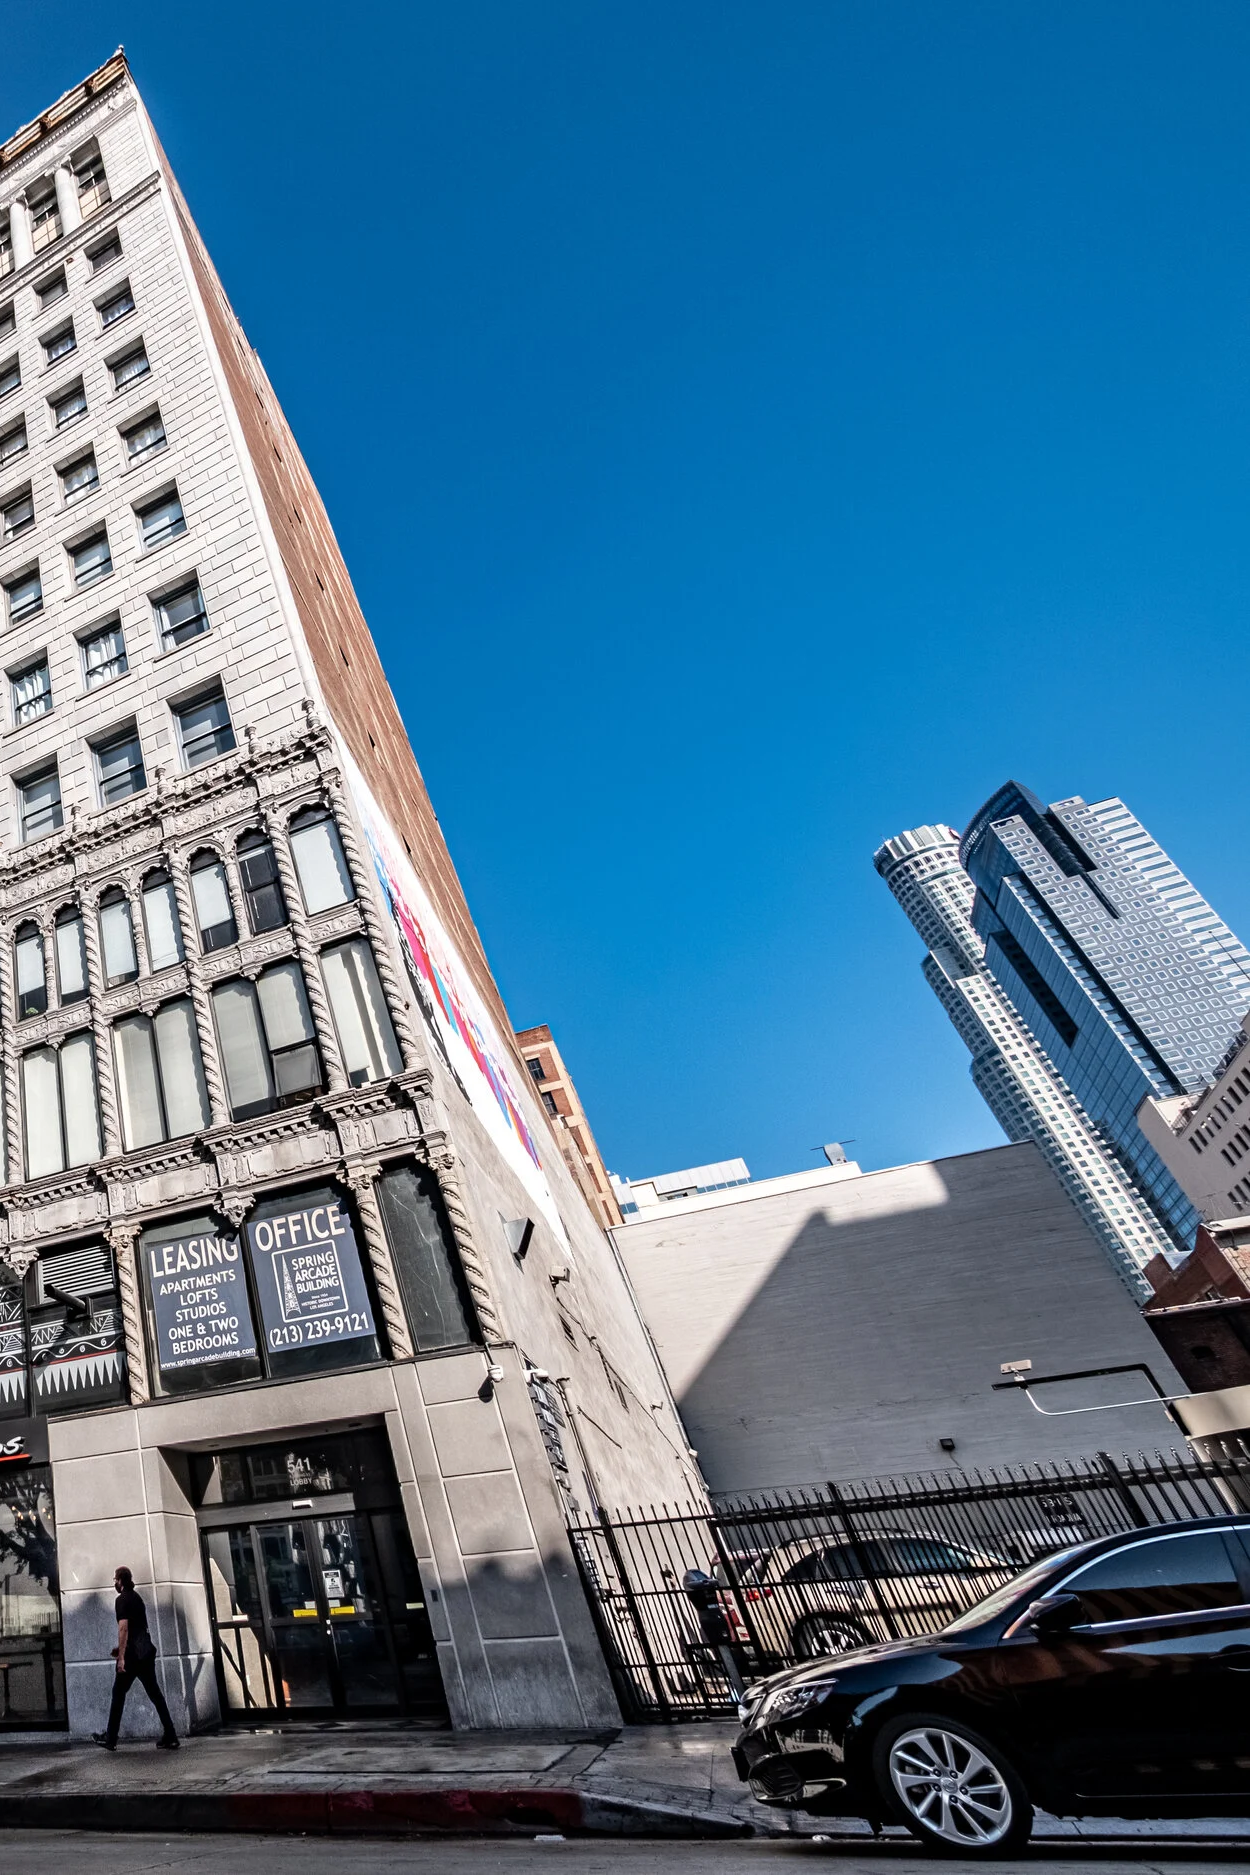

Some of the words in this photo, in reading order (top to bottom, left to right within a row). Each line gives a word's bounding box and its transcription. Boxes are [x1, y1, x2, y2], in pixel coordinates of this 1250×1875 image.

[255, 1205, 345, 1252] OFFICE
[150, 1237, 239, 1278] LEASING
[291, 1251, 335, 1271] SPRING
[159, 1269, 237, 1296] APARTMENTS
[294, 1263, 338, 1283] ARCADE
[296, 1276, 340, 1294] BUILDING
[180, 1288, 219, 1306] LOFTS
[175, 1302, 227, 1322] STUDIOS
[168, 1325, 194, 1340] ONE
[197, 1322, 207, 1335] &
[208, 1316, 239, 1333] TWO
[269, 1324, 303, 1348] (213)
[305, 1311, 369, 1340] 239-9121
[172, 1331, 240, 1355] BEDROOMS
[160, 1346, 256, 1369] www.springarcadebuilding.com
[287, 1457, 311, 1473] 541
[290, 1478, 312, 1486] LOBBY
